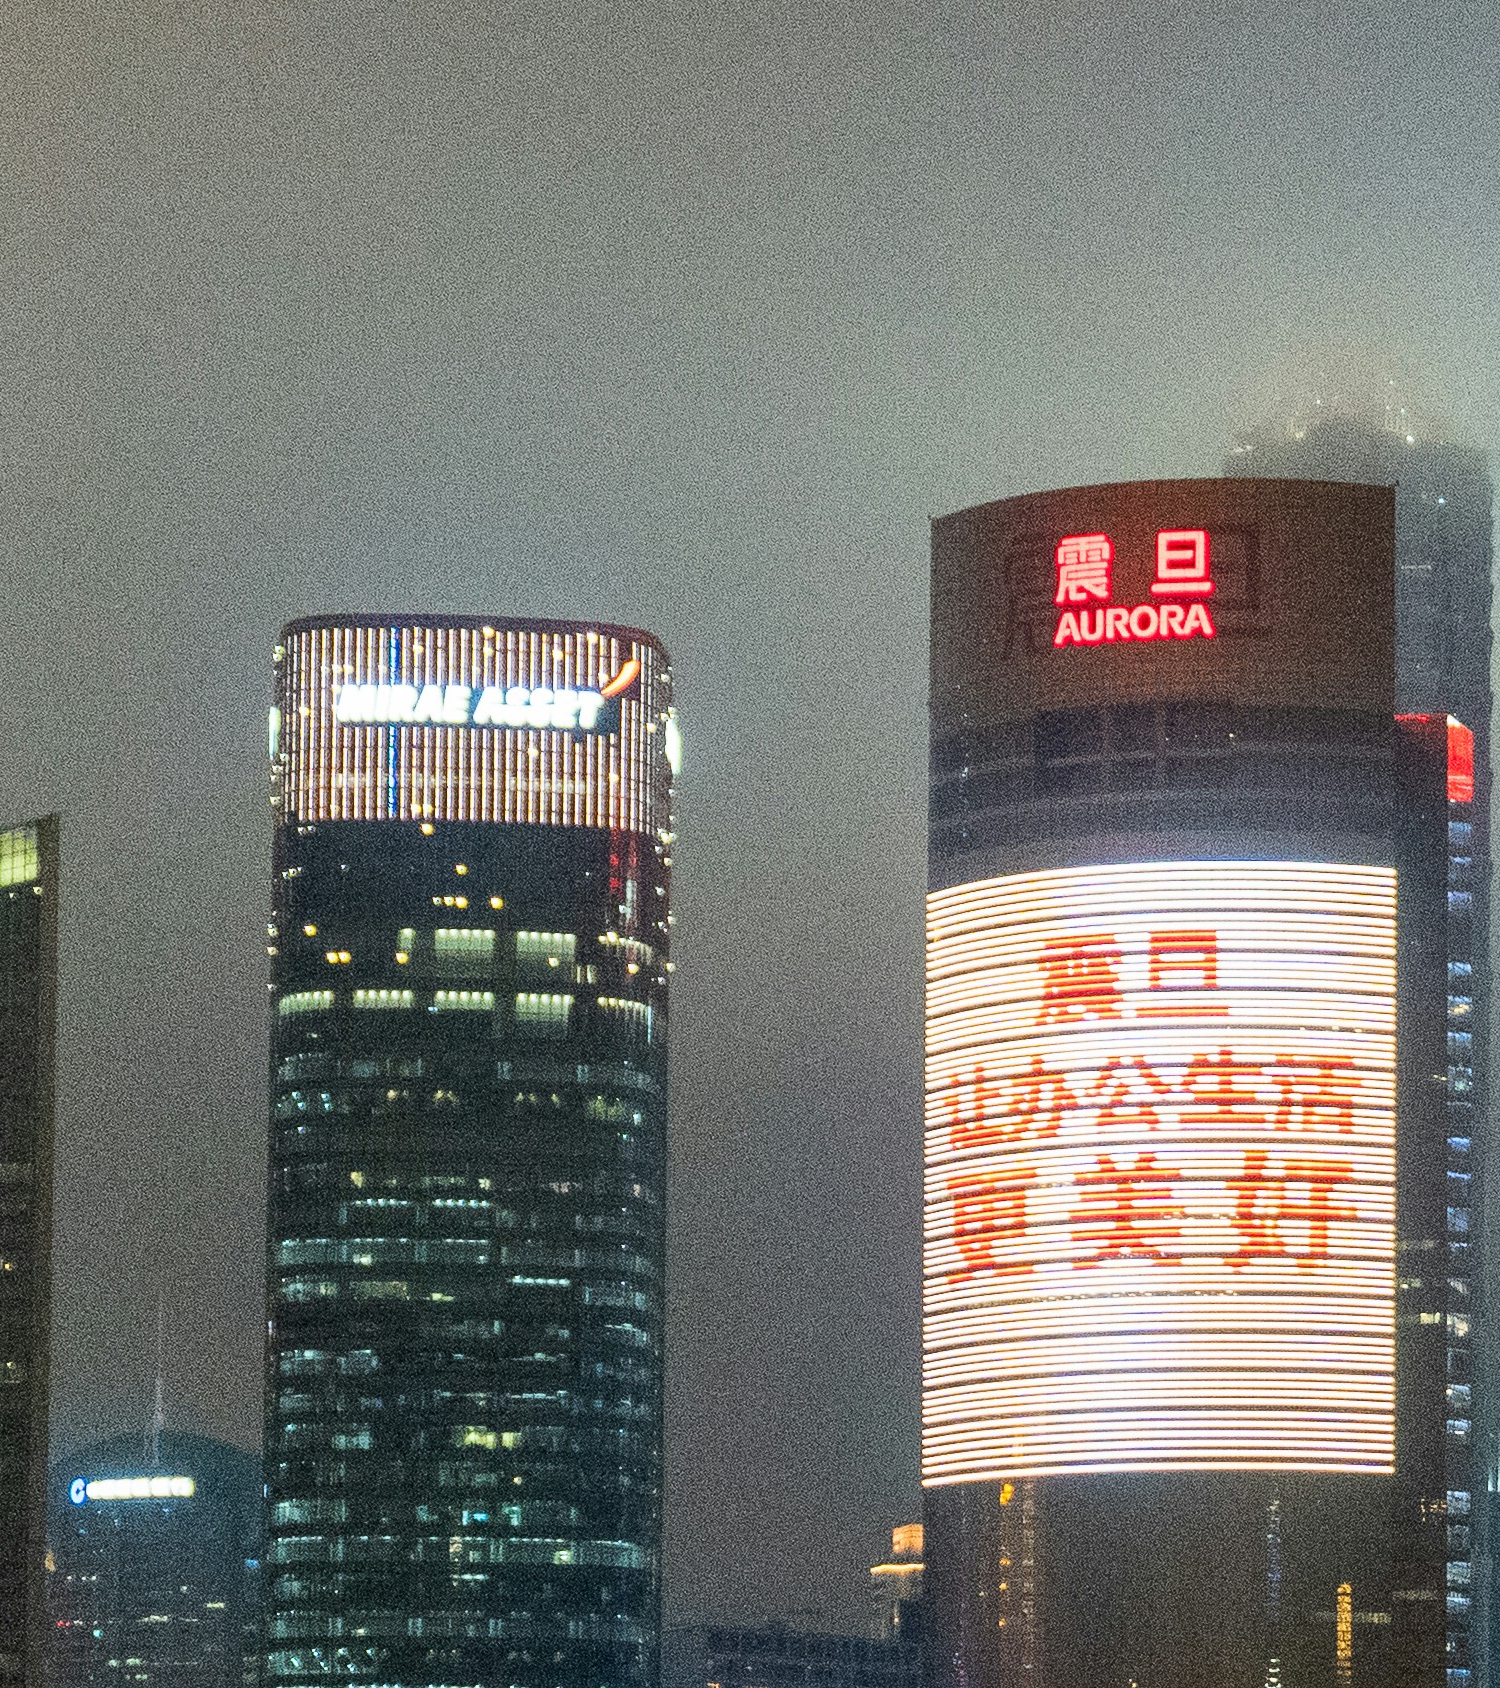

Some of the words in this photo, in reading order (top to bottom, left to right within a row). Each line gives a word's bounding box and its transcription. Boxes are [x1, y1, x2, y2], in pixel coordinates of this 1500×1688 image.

[1055, 529, 1215, 605] 震旦
[1054, 603, 1215, 647] AURORA
[336, 683, 472, 724] MIRAE
[473, 686, 604, 730] ASSET
[1035, 928, 1230, 1025] 震旦
[943, 1046, 1362, 1148] 让办公生活
[945, 1149, 1360, 1286] 更美好
